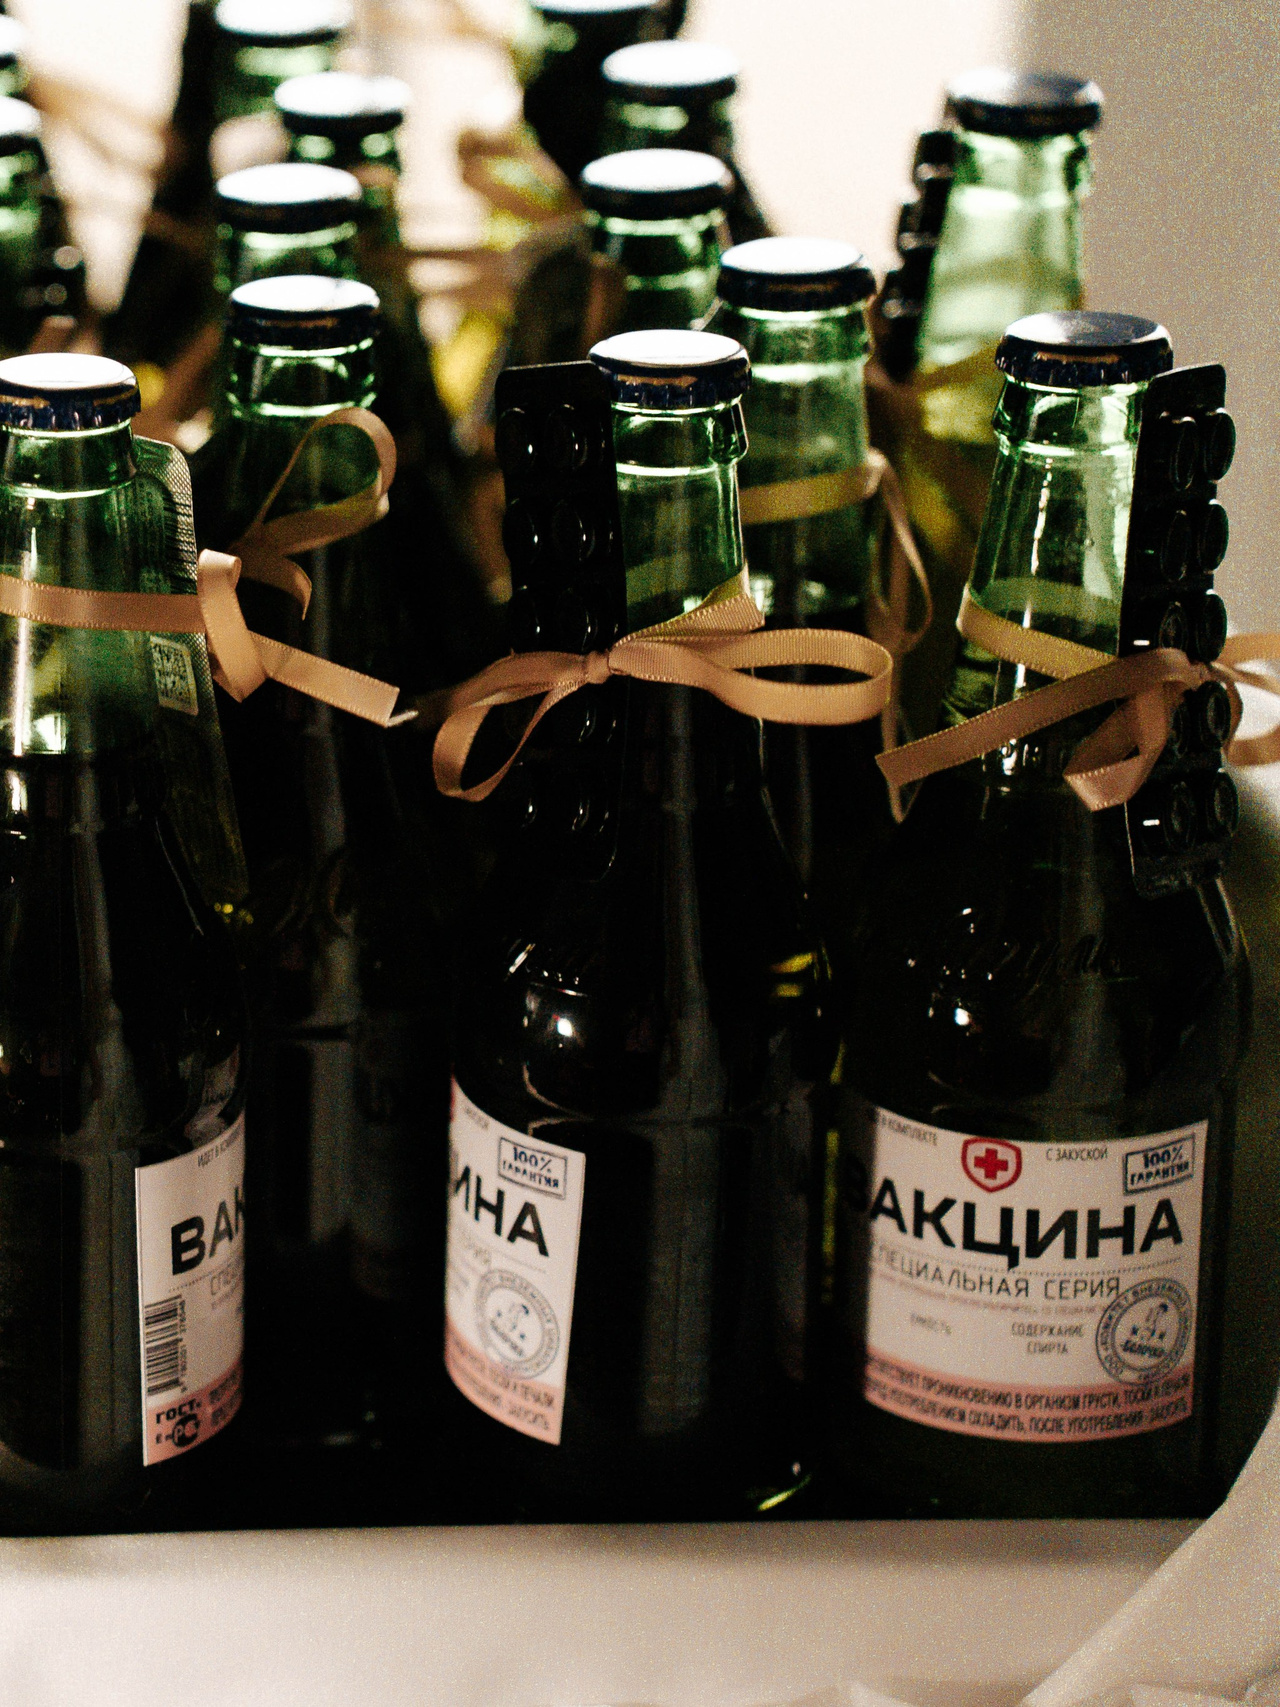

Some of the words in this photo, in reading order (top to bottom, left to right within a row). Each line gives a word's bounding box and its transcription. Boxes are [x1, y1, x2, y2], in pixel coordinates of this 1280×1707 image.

[513, 1145, 552, 1173] 100%
[1045, 1148, 1052, 1161] С
[1142, 1144, 1183, 1169] 100%
[502, 1159, 560, 1189] ГАРАНТИЯ
[1044, 1276, 1120, 1300] СЕРИЯ
[1011, 1321, 1085, 1339] СОДЕРЖАНИЕ
[1024, 1392, 1081, 1411] ОРГАНИЗМ
[1029, 1416, 1065, 1435] ПОСЛЕ
